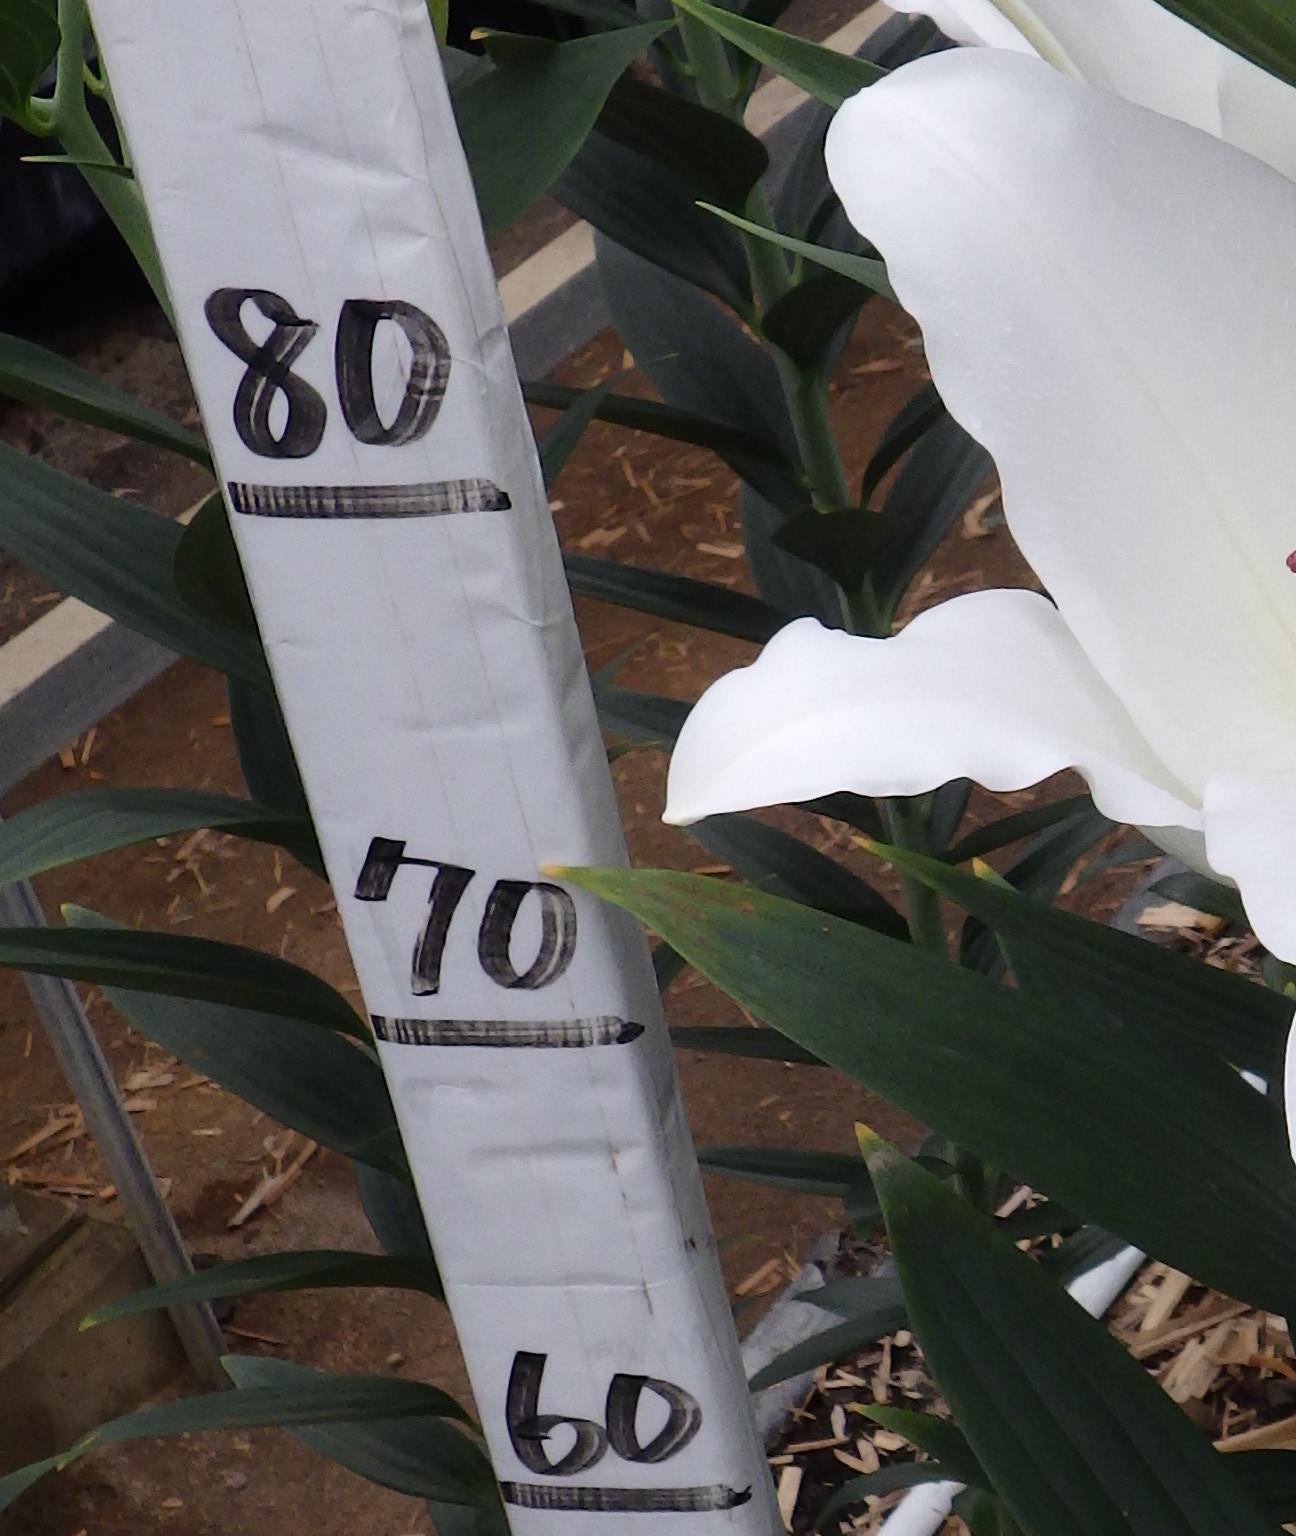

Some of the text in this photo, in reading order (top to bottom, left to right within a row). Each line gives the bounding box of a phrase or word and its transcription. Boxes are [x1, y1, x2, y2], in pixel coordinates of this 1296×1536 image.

[204, 287, 451, 459] 80
[355, 836, 577, 996] 70
[506, 1350, 702, 1476] 60
